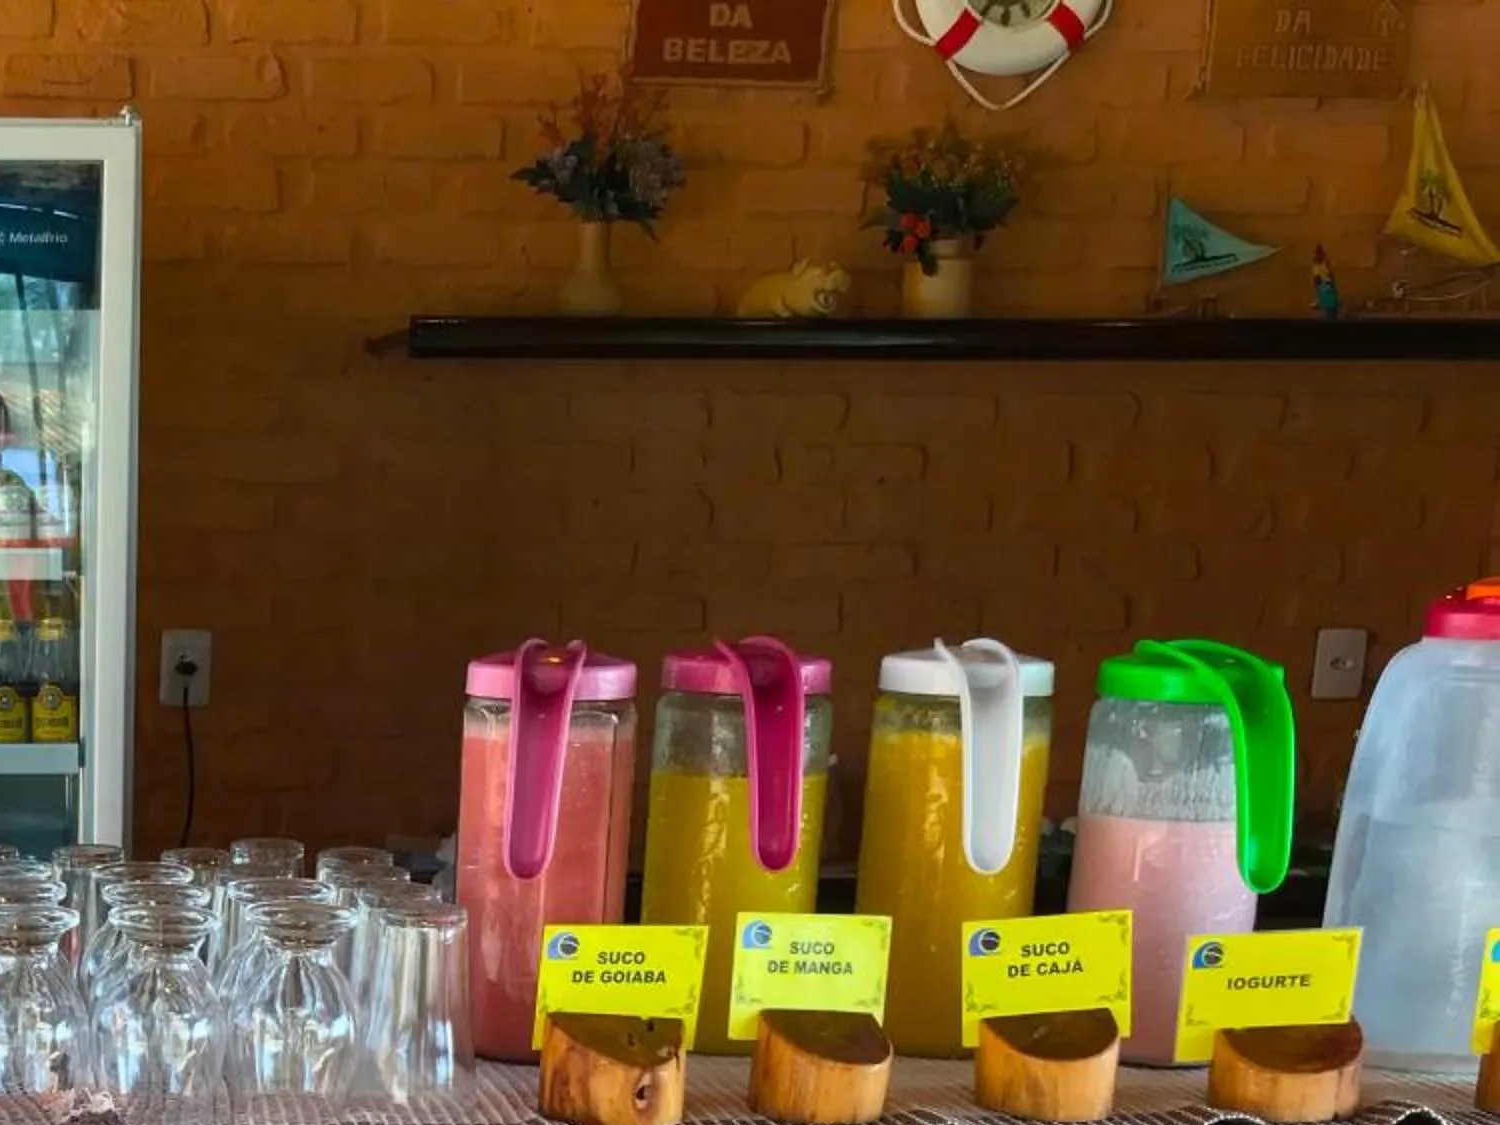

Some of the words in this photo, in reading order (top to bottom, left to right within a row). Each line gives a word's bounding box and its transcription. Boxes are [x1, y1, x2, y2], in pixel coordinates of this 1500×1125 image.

[709, 3, 753, 29] DA
[663, 37, 791, 65] BELEZA
[789, 941, 835, 955] SUCO
[1021, 941, 1070, 957] SUCO
[596, 951, 645, 965] SUCO
[767, 960, 789, 973] DE
[794, 960, 853, 974] MANGA
[1007, 964, 1030, 978] DE
[571, 970, 595, 983] DE
[600, 970, 666, 983] GOIABA
[1227, 974, 1311, 990] IOGURTE
